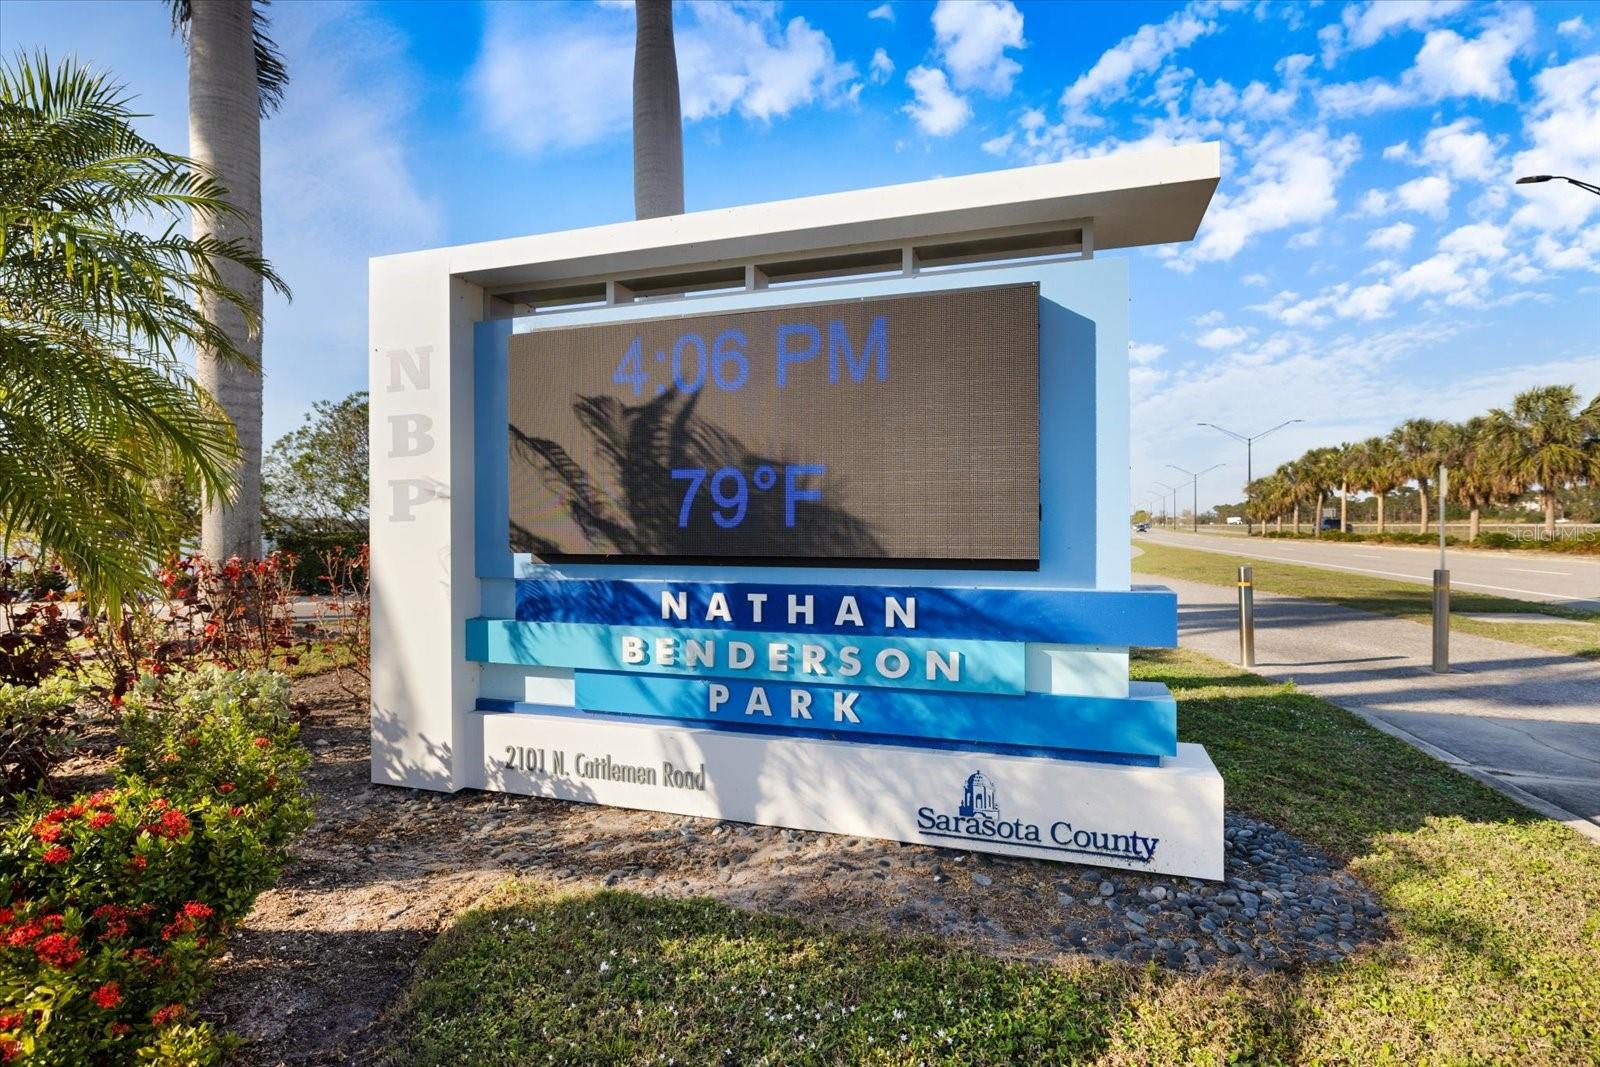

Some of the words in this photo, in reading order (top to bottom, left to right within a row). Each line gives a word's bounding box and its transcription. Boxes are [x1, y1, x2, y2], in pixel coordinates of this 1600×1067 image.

[611, 328, 749, 396] 4:06
[775, 315, 890, 389] PM
[670, 463, 828, 529] 79°F
[661, 591, 916, 629] NATHAN
[622, 636, 961, 682] BENDERSON
[709, 684, 861, 723] PARK
[505, 745, 545, 772] 2101
[553, 750, 570, 777] N.
[575, 753, 657, 786] Cattlemen
[662, 761, 706, 791] Road
[917, 806, 1041, 843] Sarasota
[1050, 821, 1160, 858] County
